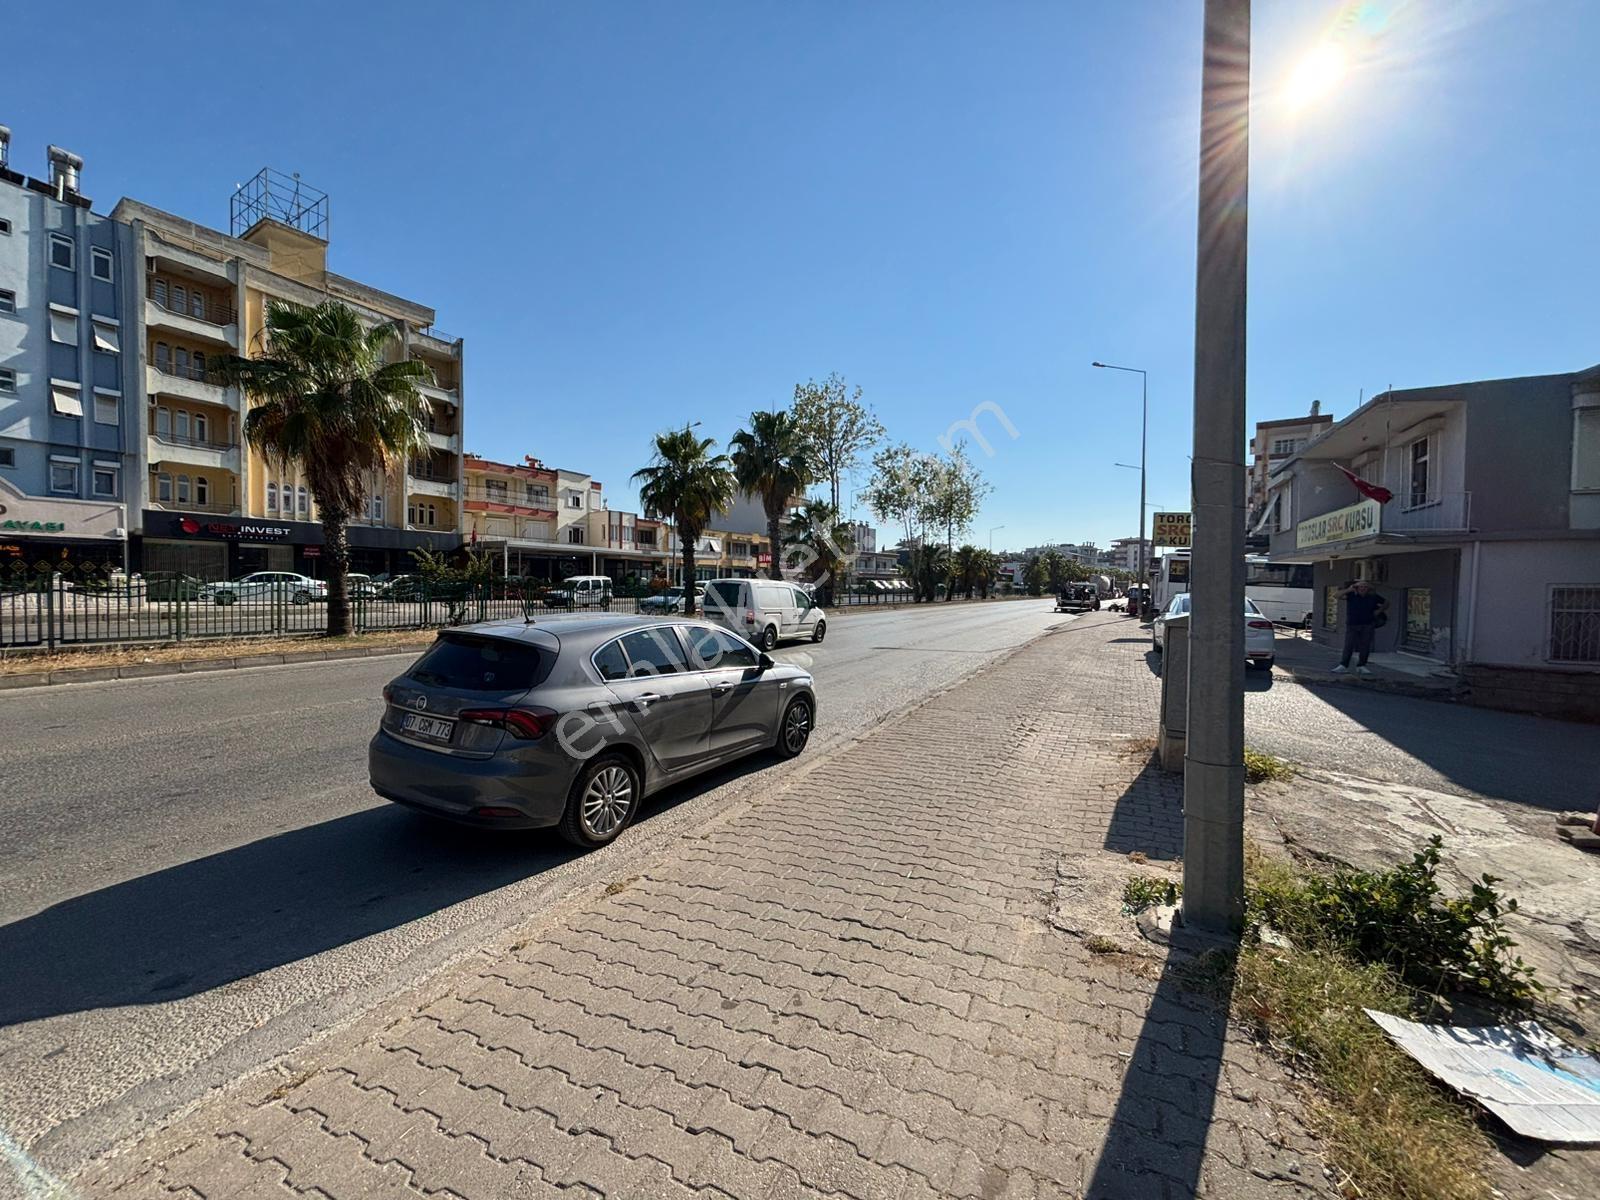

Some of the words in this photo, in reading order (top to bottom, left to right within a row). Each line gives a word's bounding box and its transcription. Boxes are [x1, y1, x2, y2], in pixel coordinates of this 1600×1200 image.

[1327, 513, 1344, 534] SRC
[1344, 505, 1374, 533] KURSU
[240, 525, 291, 535] INVEST
[1157, 524, 1191, 536] SRC
[1169, 536, 1191, 545] KU
[406, 715, 416, 729] 07
[436, 721, 451, 737] 773
